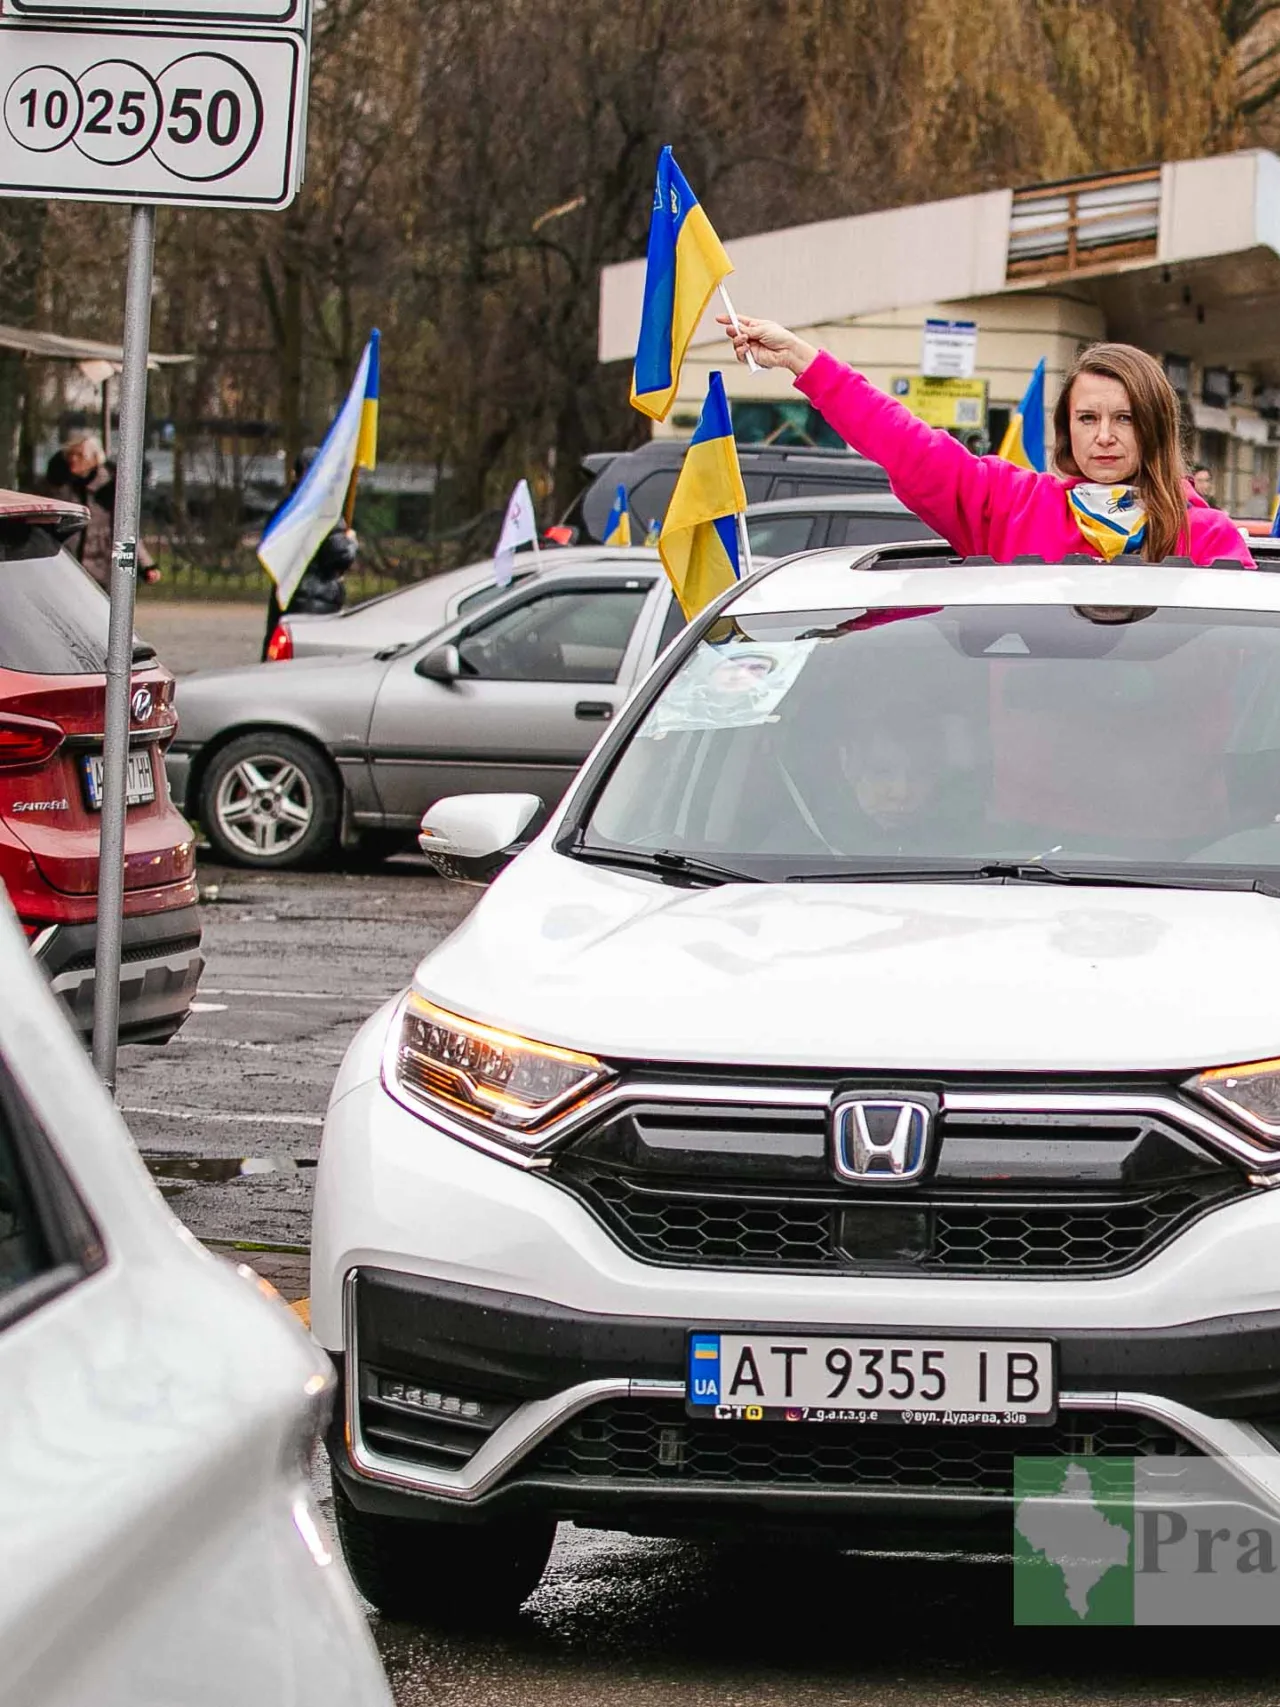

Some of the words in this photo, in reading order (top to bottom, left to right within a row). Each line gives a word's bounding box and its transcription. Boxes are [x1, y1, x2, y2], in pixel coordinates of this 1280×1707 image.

[19, 87, 69, 129] 10
[82, 89, 146, 135] 25
[166, 88, 241, 146] 50
[695, 1379, 718, 1395] UA
[729, 1346, 808, 1396] AT
[825, 1347, 947, 1400] 9355
[977, 1351, 1040, 1403] IB
[914, 1413, 940, 1425] вул.
